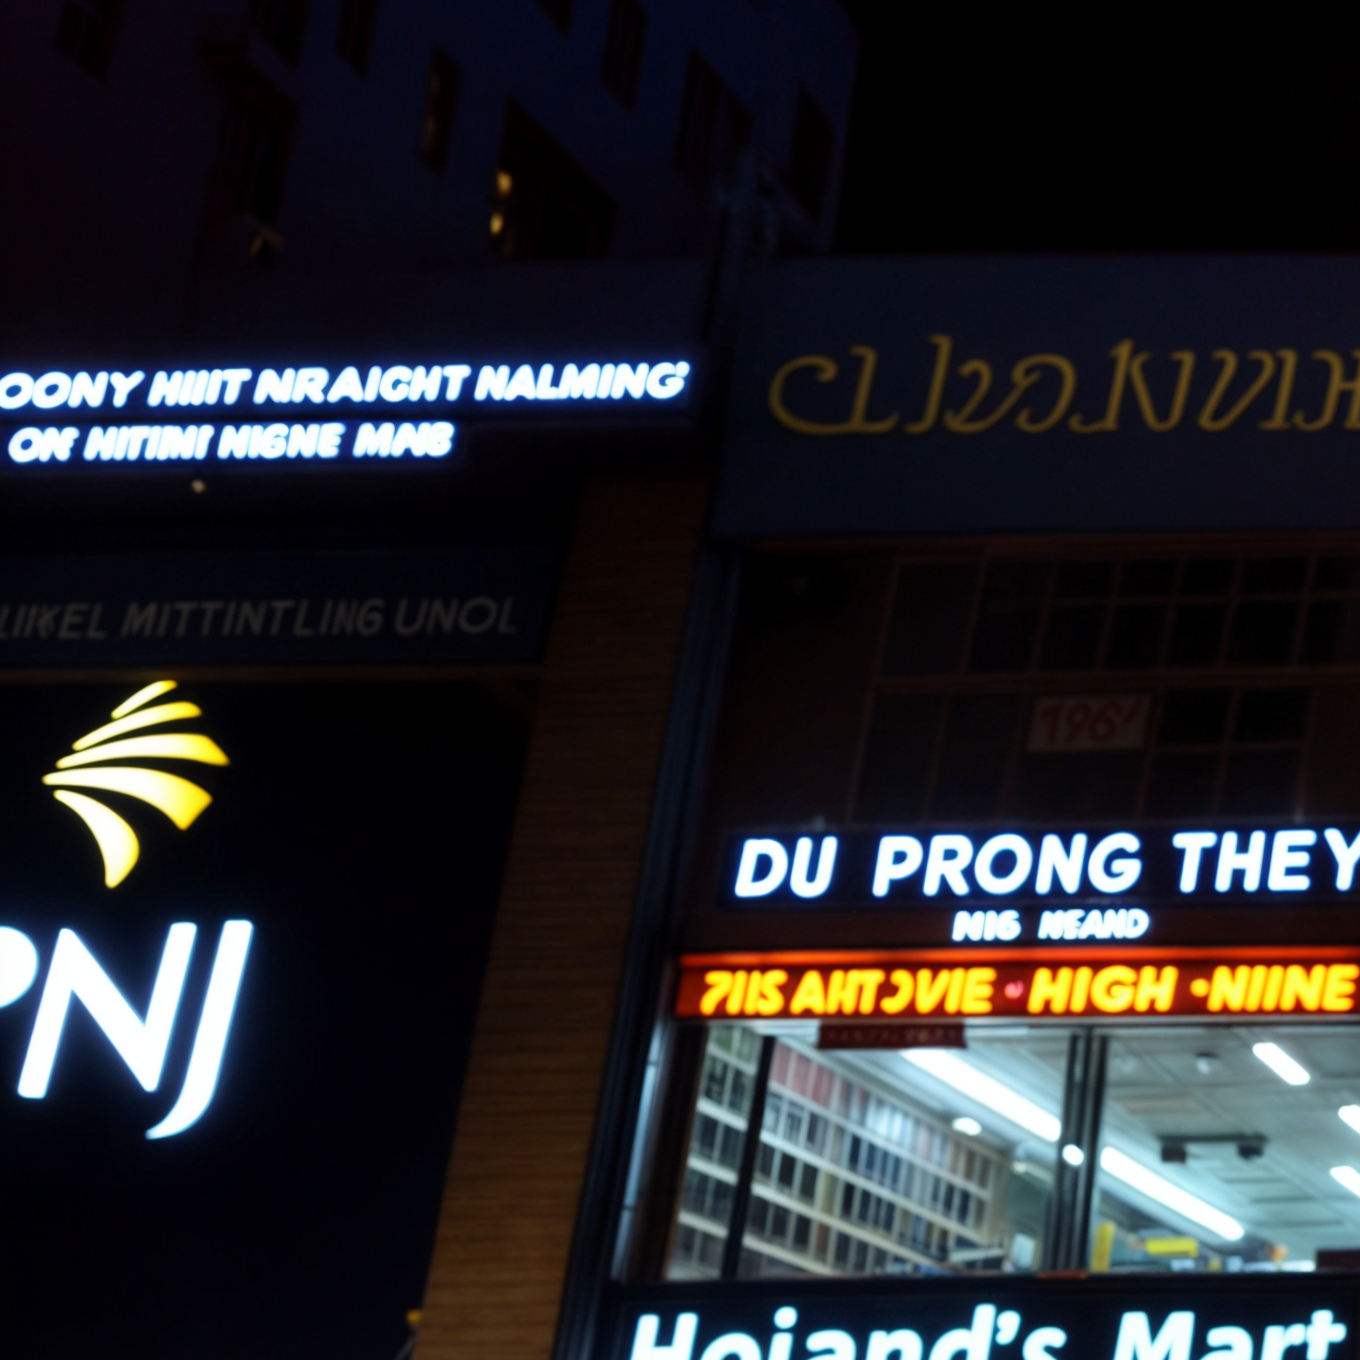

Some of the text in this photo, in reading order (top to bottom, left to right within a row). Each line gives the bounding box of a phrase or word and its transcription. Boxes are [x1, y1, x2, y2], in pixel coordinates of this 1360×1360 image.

[734, 835, 839, 899] DU
[872, 831, 1142, 898] PRONG
[1027, 965, 1179, 1014] HIGH
